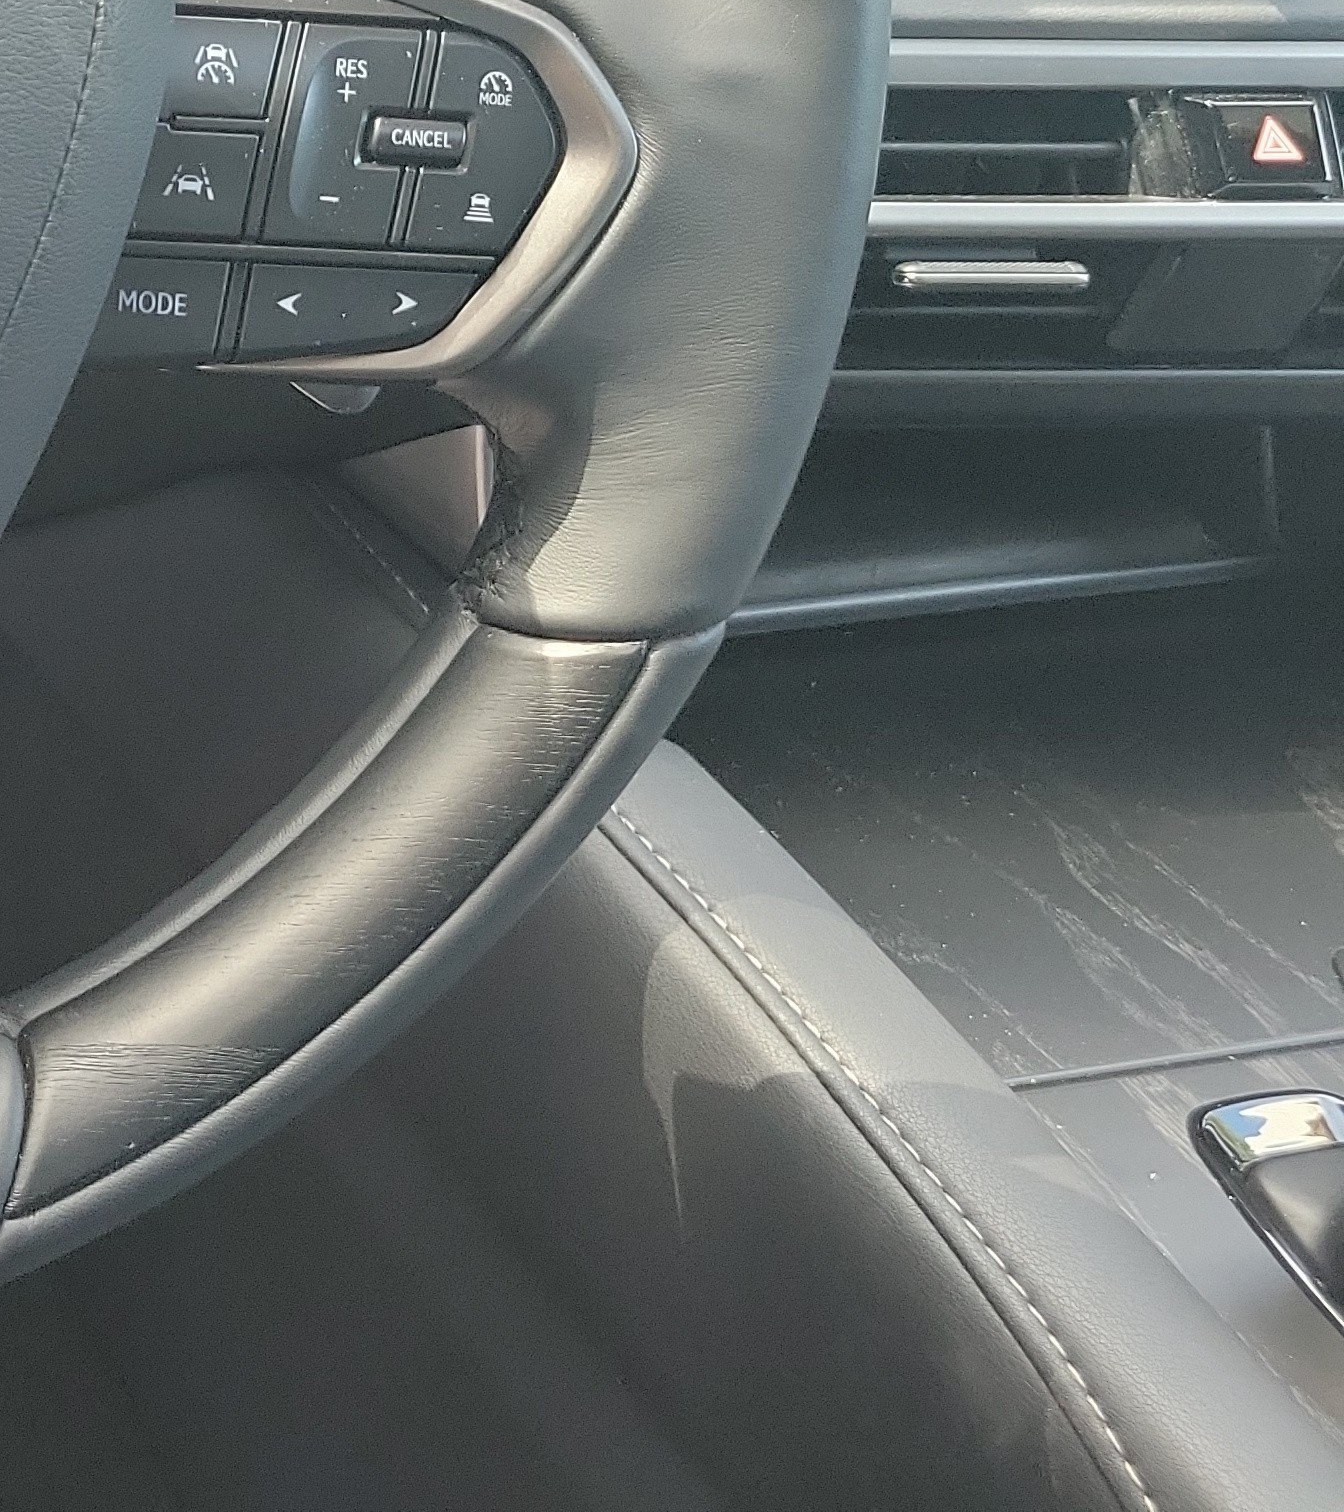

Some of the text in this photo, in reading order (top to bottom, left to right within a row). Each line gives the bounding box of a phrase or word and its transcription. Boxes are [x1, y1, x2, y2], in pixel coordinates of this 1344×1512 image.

[335, 57, 368, 80] RES
[478, 90, 512, 107] MODE
[391, 128, 452, 150] CANCEL
[117, 289, 188, 317] MODE
